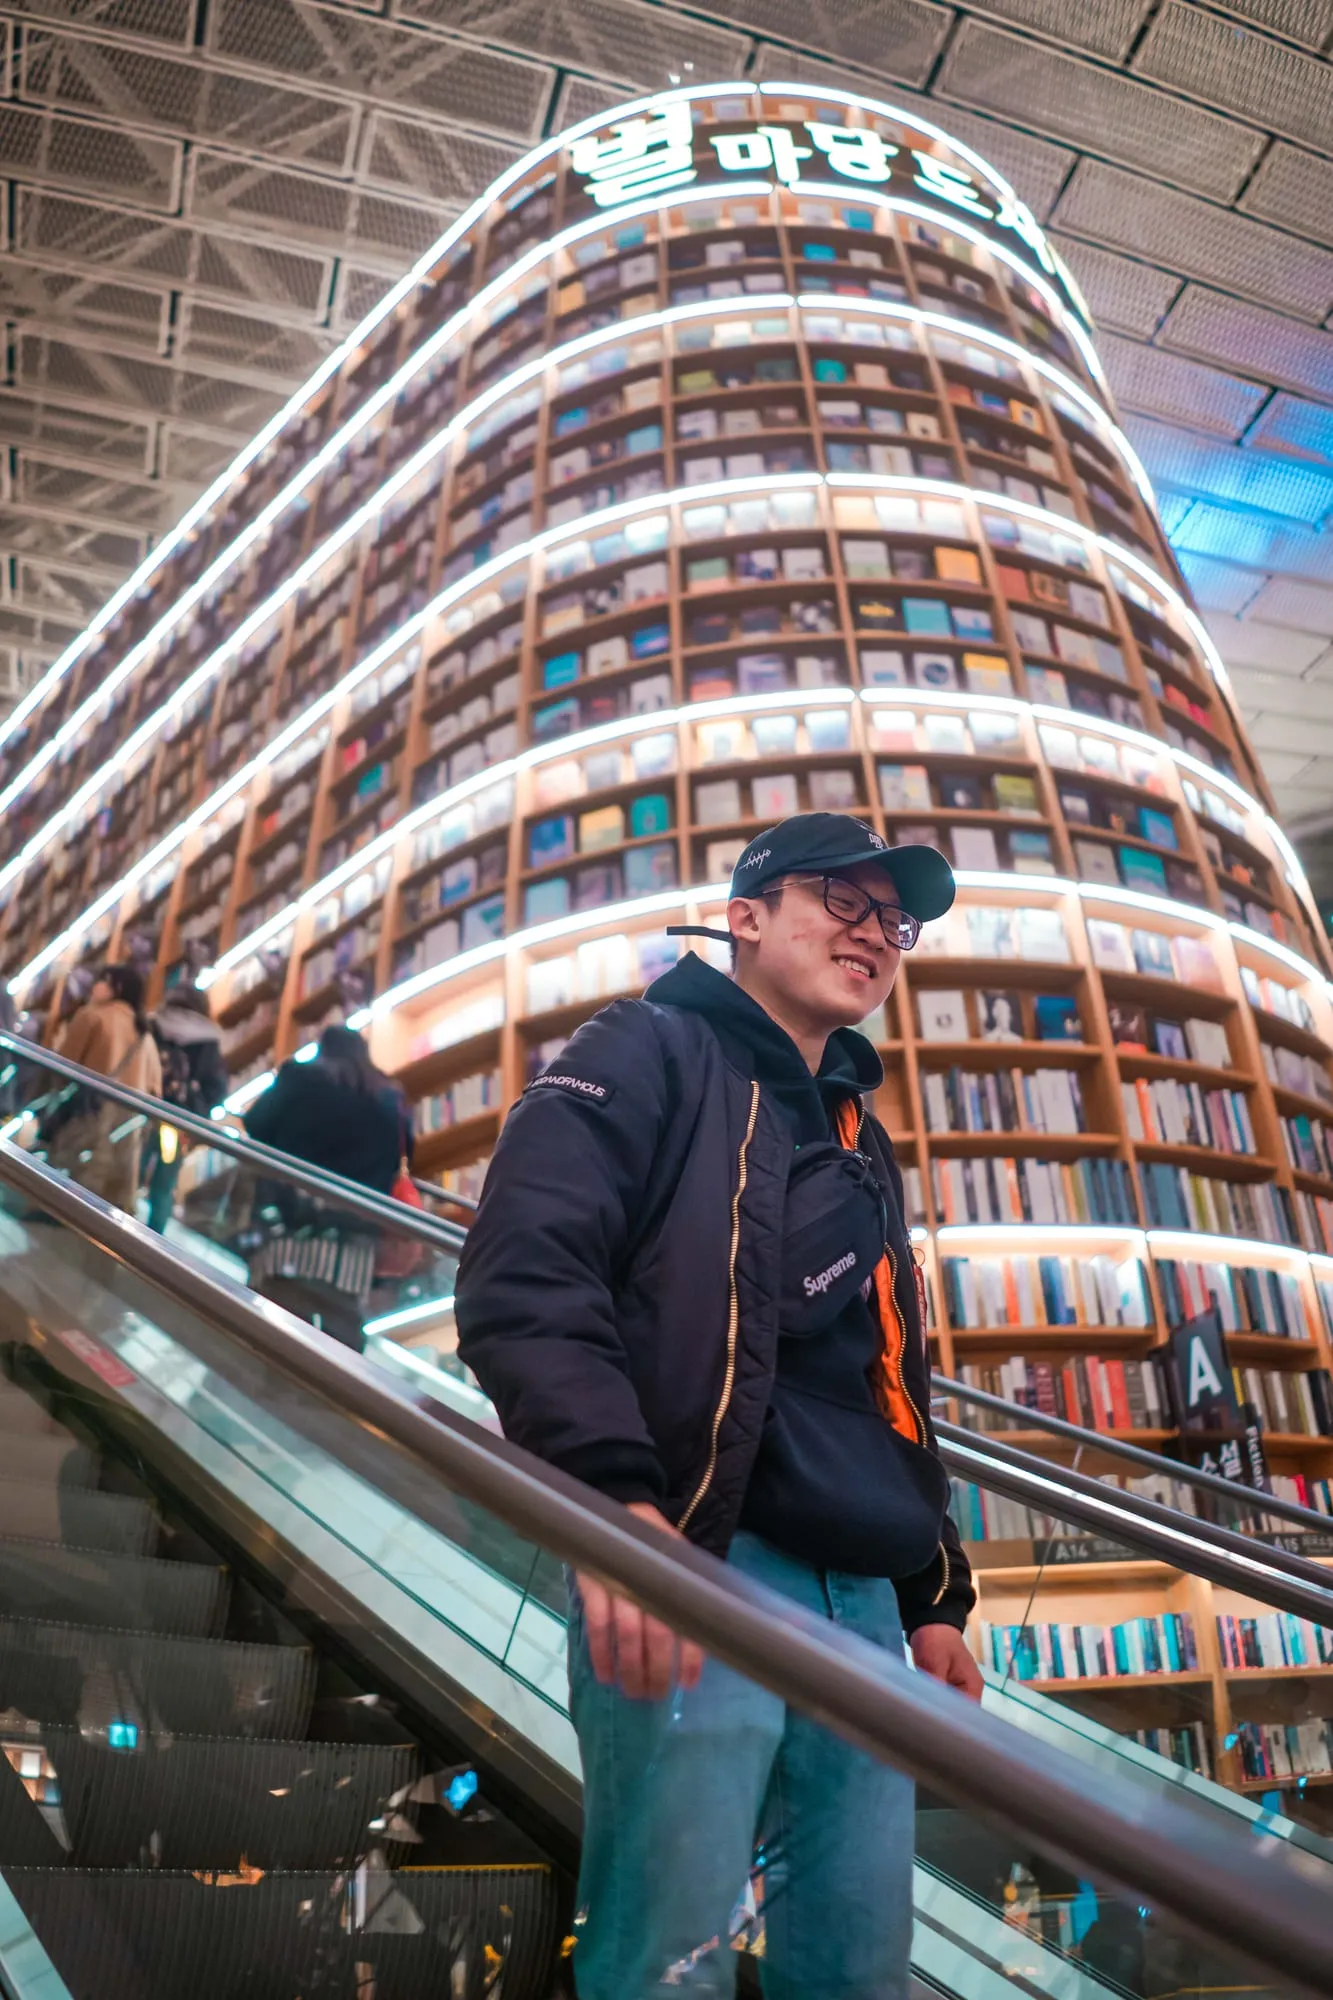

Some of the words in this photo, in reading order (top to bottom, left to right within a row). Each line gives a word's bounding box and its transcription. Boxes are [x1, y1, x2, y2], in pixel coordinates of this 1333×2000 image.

[803, 1251, 856, 1297] Supreme
[1188, 1335, 1223, 1407] A
[1200, 1439, 1242, 1479] 소설
[1245, 1425, 1264, 1488] Fiction
